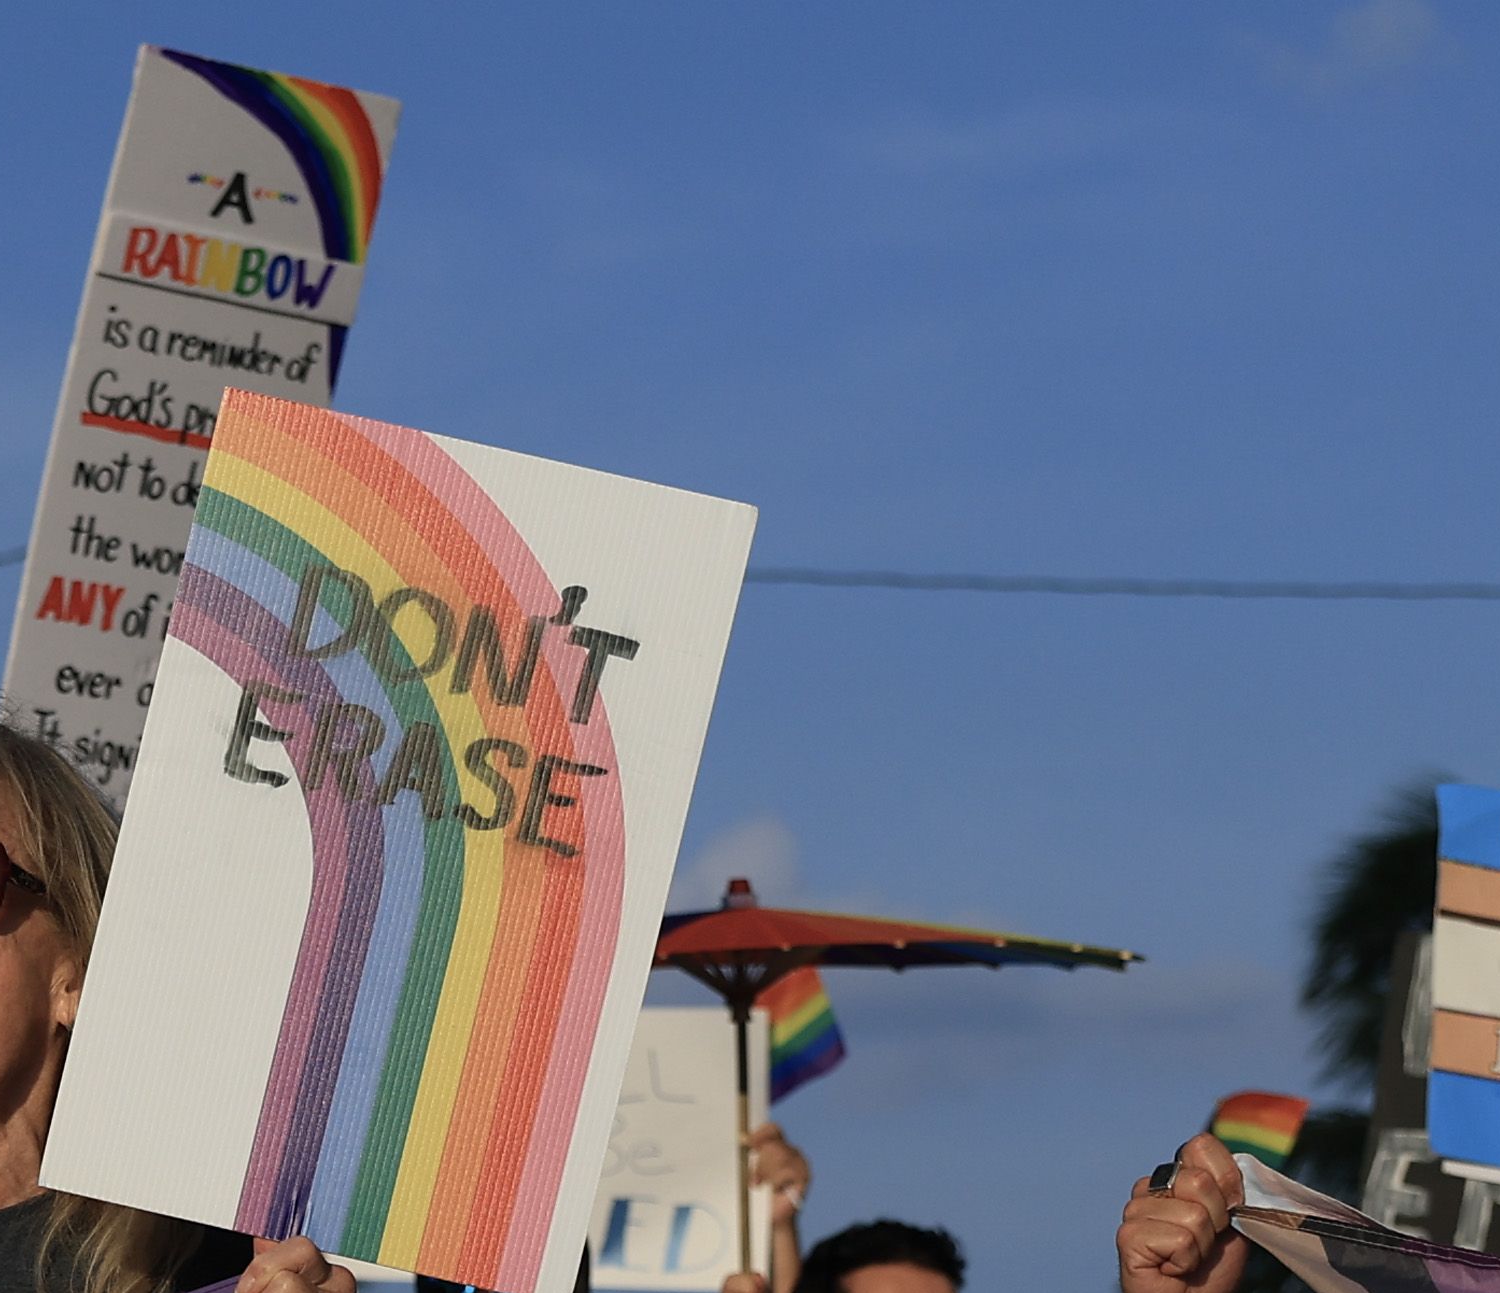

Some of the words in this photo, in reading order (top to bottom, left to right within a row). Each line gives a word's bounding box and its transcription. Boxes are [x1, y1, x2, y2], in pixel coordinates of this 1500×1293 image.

[211, 172, 253, 225] A
[122, 227, 336, 309] RAINBOW
[103, 305, 132, 348] is
[139, 326, 158, 354] a
[167, 331, 282, 376] reminder
[285, 342, 322, 384] of
[87, 368, 173, 428] God's
[139, 457, 166, 501] to
[70, 514, 121, 563] the
[36, 576, 125, 632] ANY
[122, 594, 158, 638] of
[288, 563, 640, 726] DON'T
[55, 665, 123, 699] ever
[224, 681, 609, 858] ERASE
